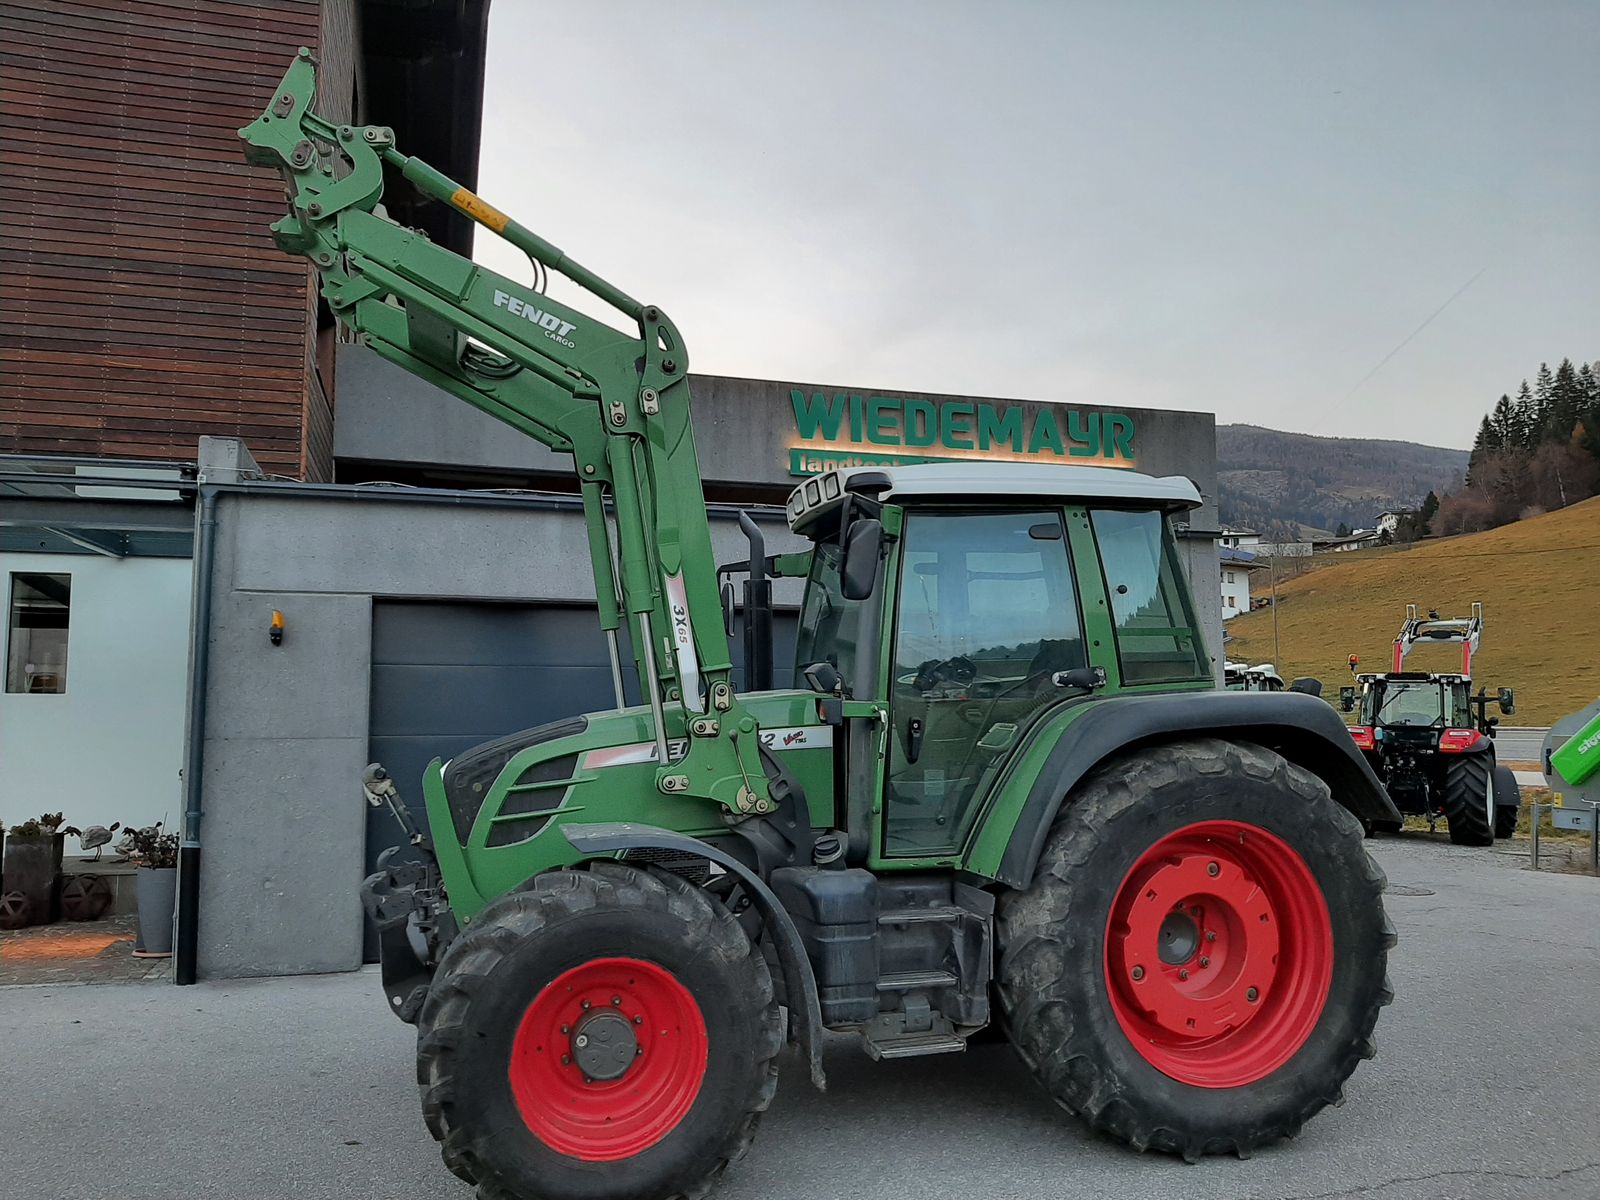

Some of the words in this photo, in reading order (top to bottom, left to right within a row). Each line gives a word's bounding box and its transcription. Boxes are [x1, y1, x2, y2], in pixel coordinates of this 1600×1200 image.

[493, 289, 577, 337] FENDT
[544, 330, 576, 350] CARGO
[791, 389, 1136, 459] WIEDEMAYR
